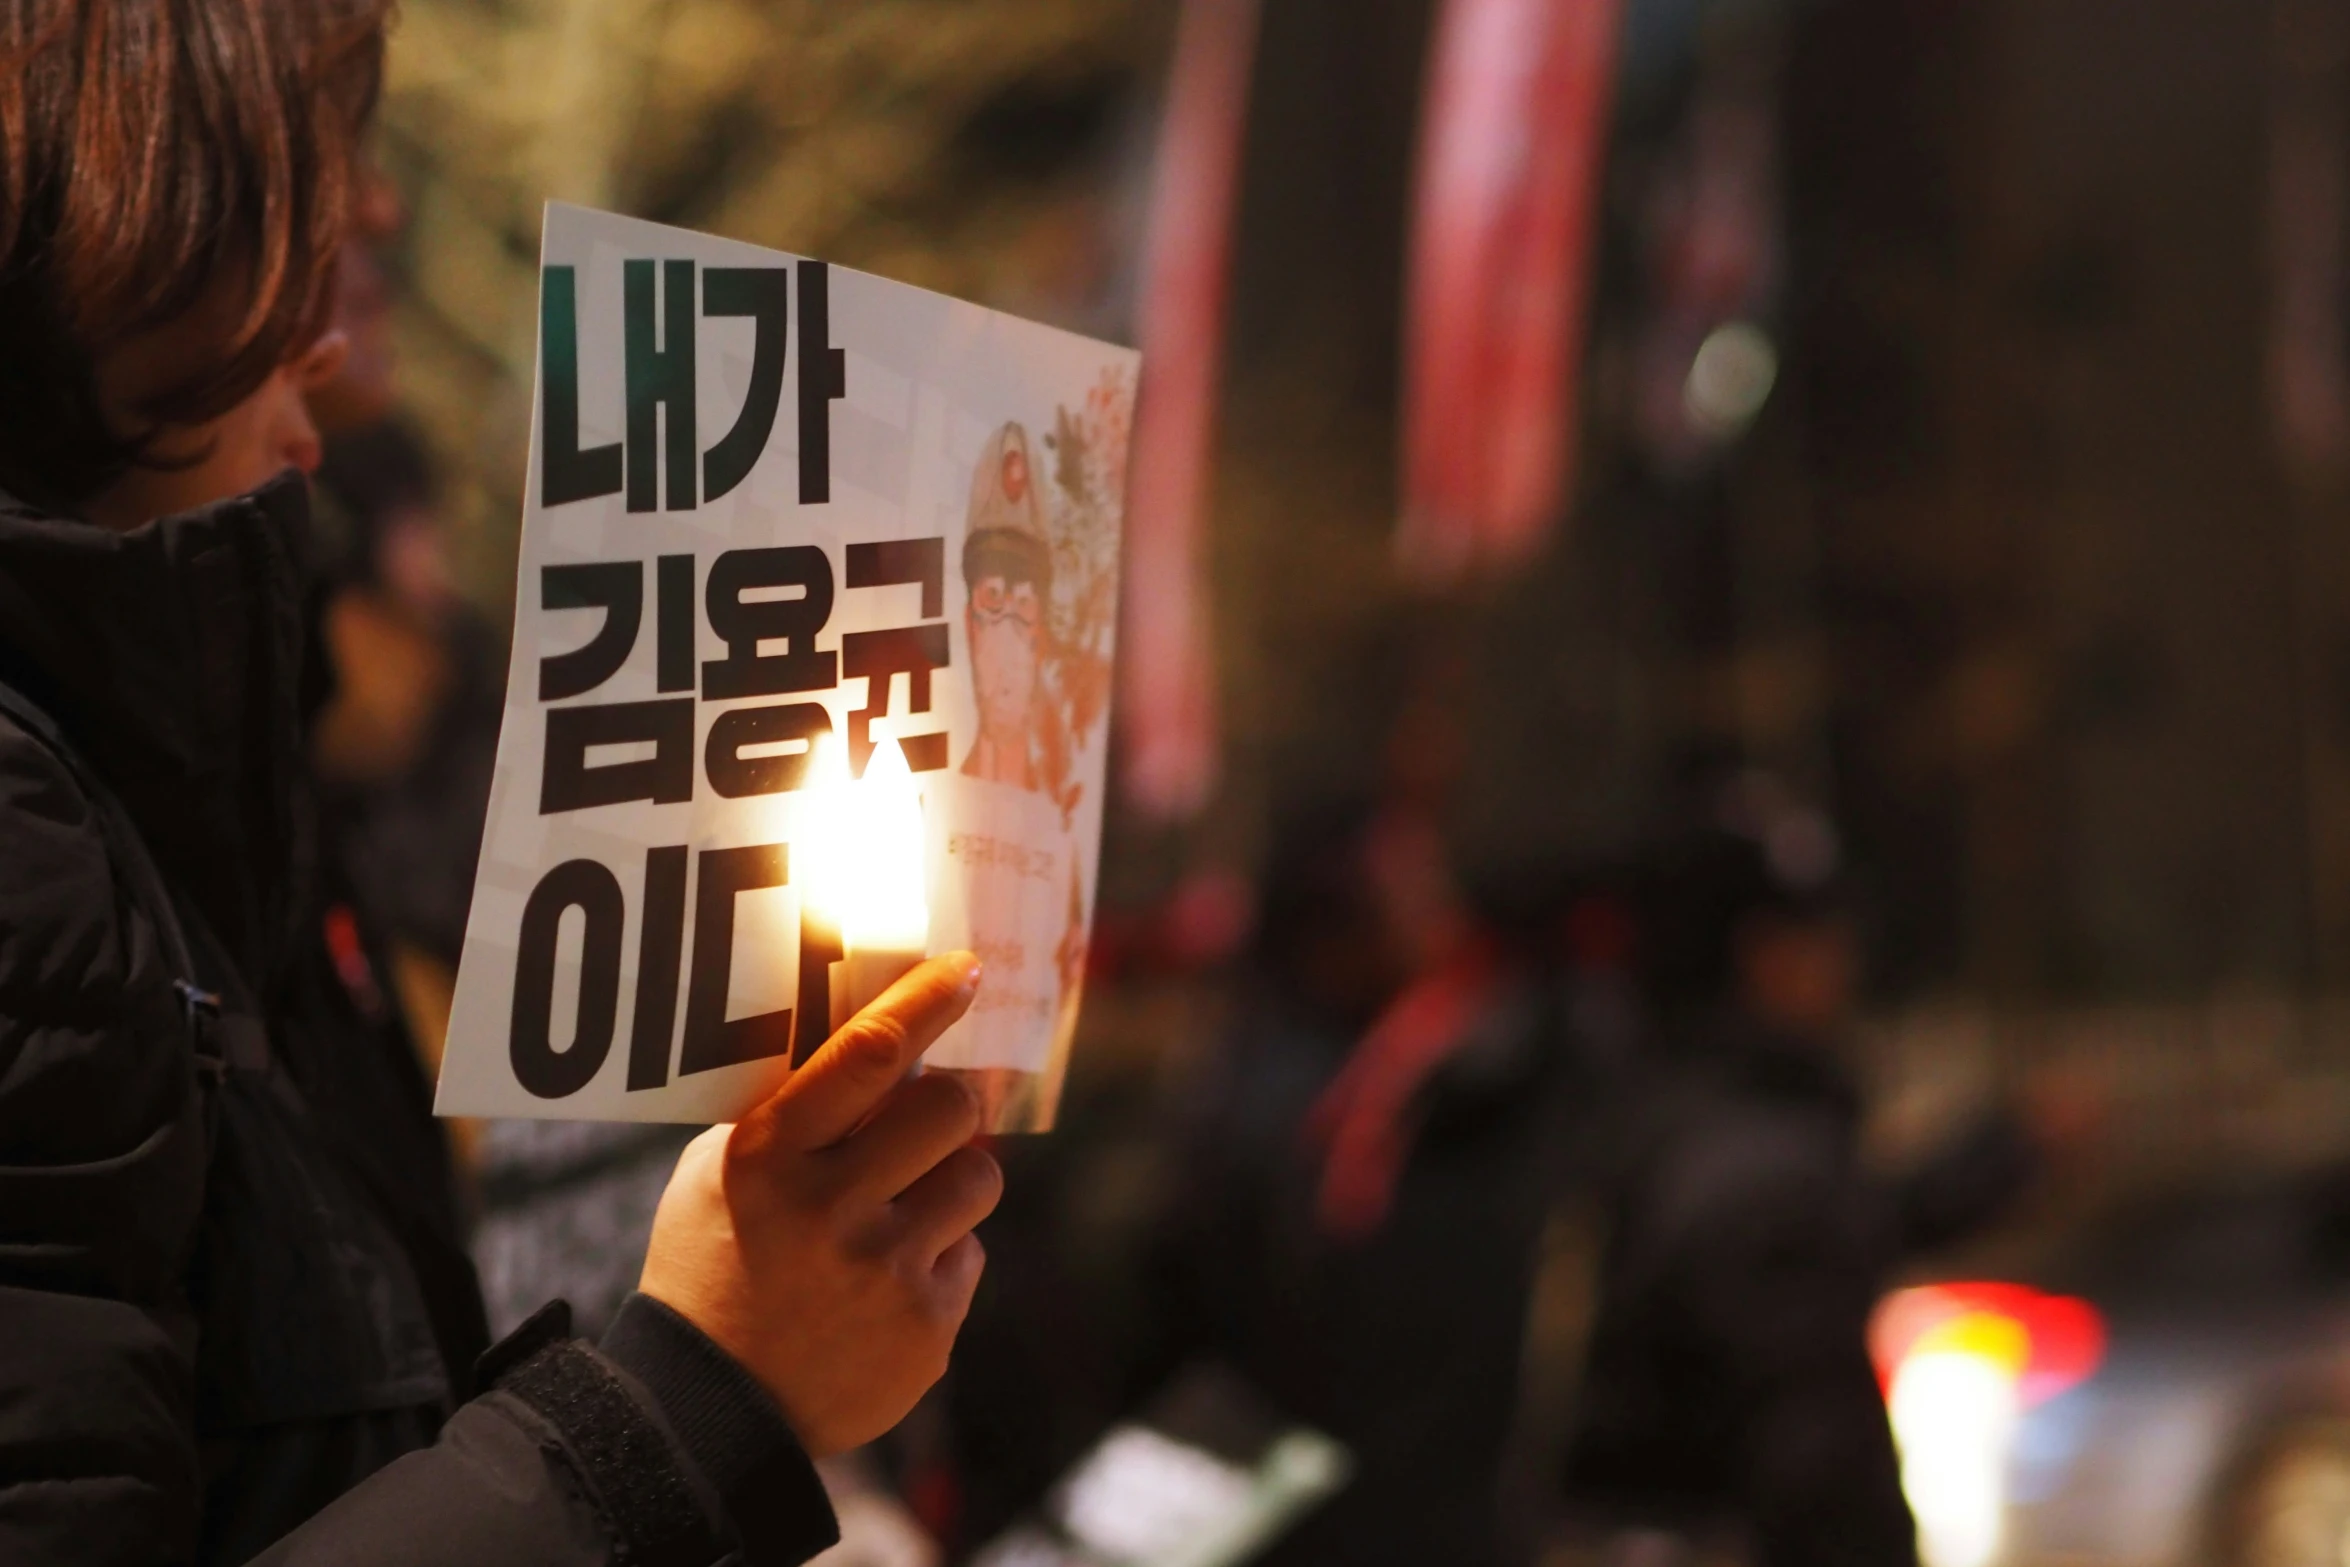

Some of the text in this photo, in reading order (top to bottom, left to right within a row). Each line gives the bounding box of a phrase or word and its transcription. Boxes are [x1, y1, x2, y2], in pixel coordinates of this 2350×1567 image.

[542, 259, 845, 513] 내가
[538, 537, 950, 815] 김용균
[509, 842, 844, 1098] 이다
